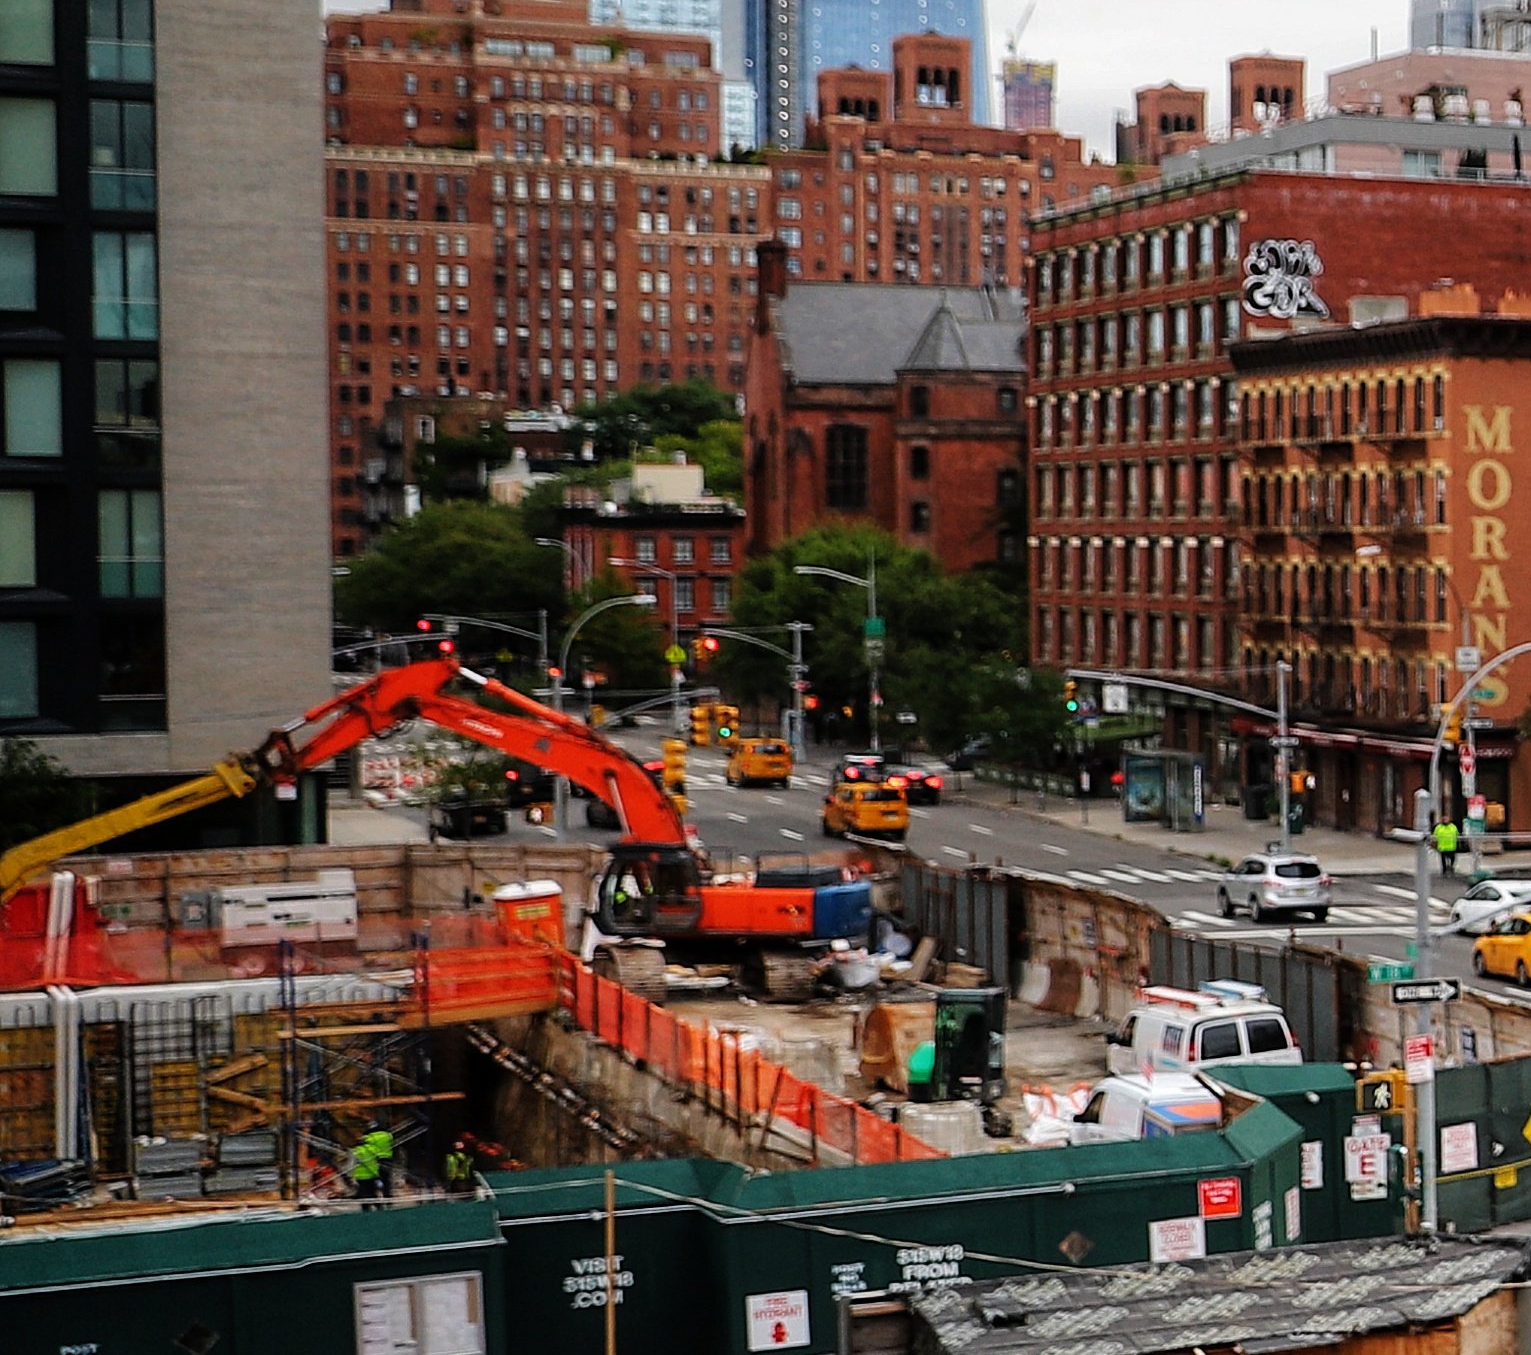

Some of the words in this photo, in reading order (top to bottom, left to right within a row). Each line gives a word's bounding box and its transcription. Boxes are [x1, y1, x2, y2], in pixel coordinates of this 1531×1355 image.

[1349, 1137, 1388, 1153] GATE
[1361, 1154, 1377, 1175] E
[902, 1262, 960, 1281] FROM
[753, 1304, 804, 1320] HYDRANT
